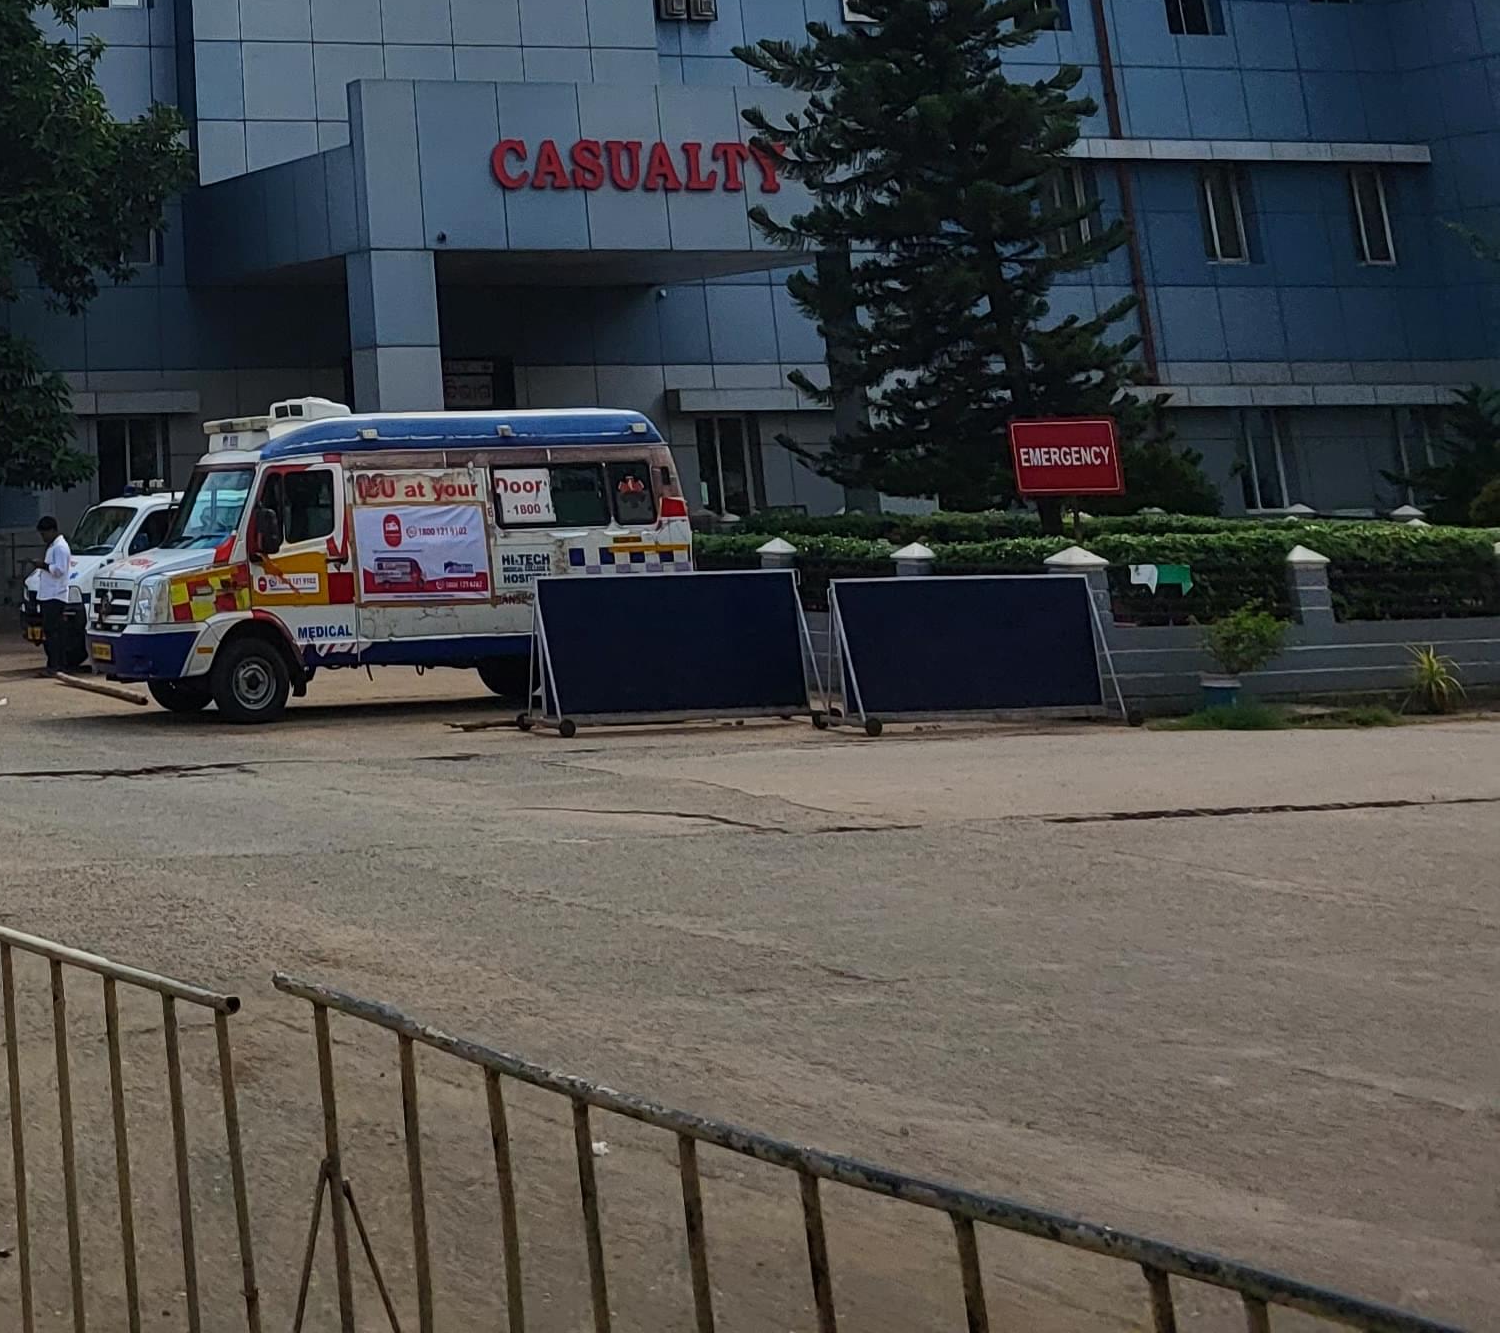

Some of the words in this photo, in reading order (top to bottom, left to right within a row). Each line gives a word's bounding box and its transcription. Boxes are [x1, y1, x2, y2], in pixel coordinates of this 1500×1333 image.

[489, 138, 786, 194] CASUALTY
[1020, 446, 1110, 467] EMERGENCY
[404, 482, 426, 498] at
[431, 481, 478, 502] your
[513, 503, 541, 516] 1800
[297, 623, 353, 639] MEDICAL
